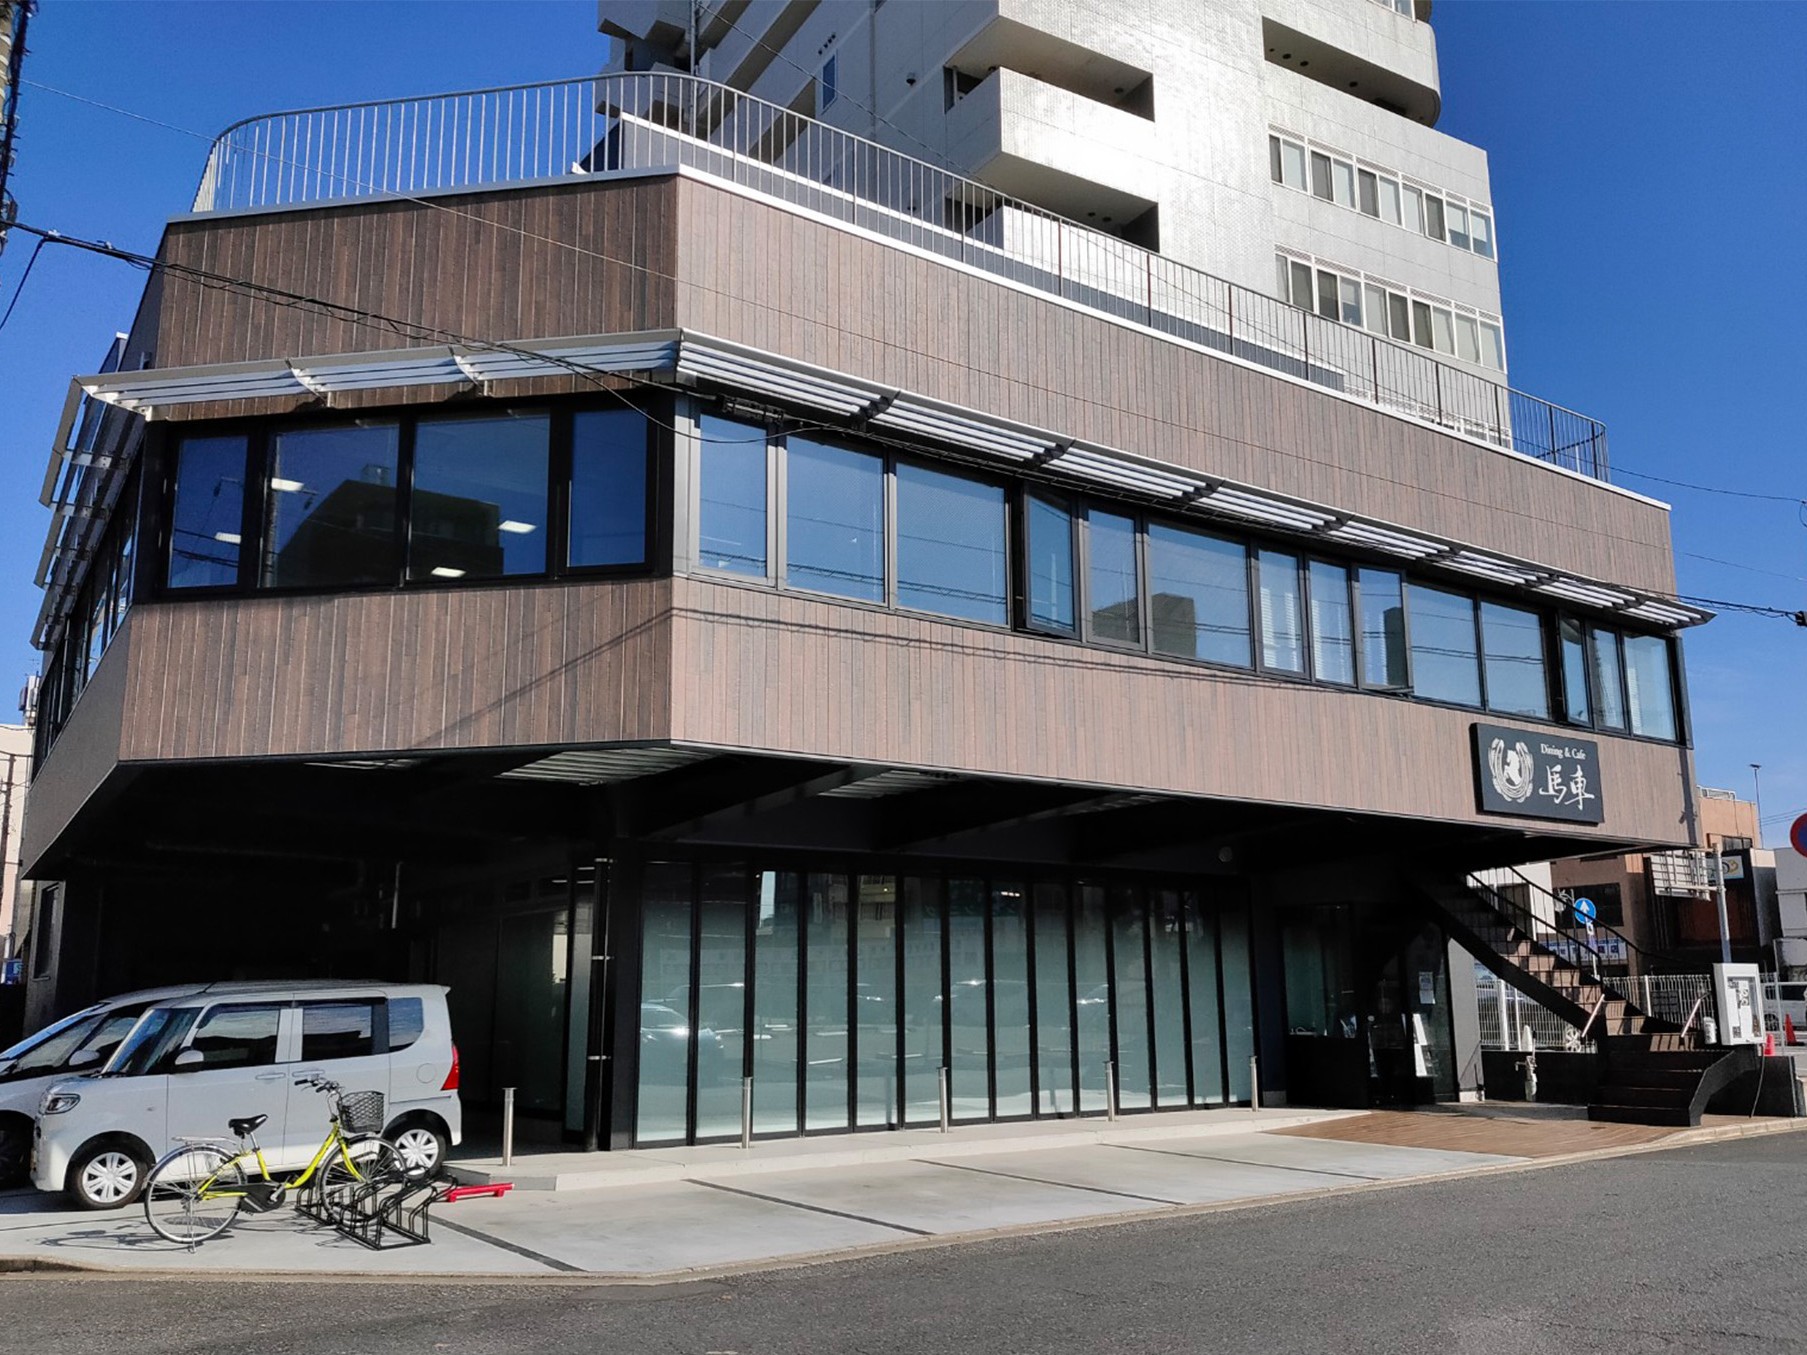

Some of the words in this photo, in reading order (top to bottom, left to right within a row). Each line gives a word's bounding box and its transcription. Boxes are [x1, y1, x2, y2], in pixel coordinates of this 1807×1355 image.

[1540, 743, 1563, 759] Dining
[1564, 747, 1571, 758] &
[1538, 764, 1595, 810] 馬車
